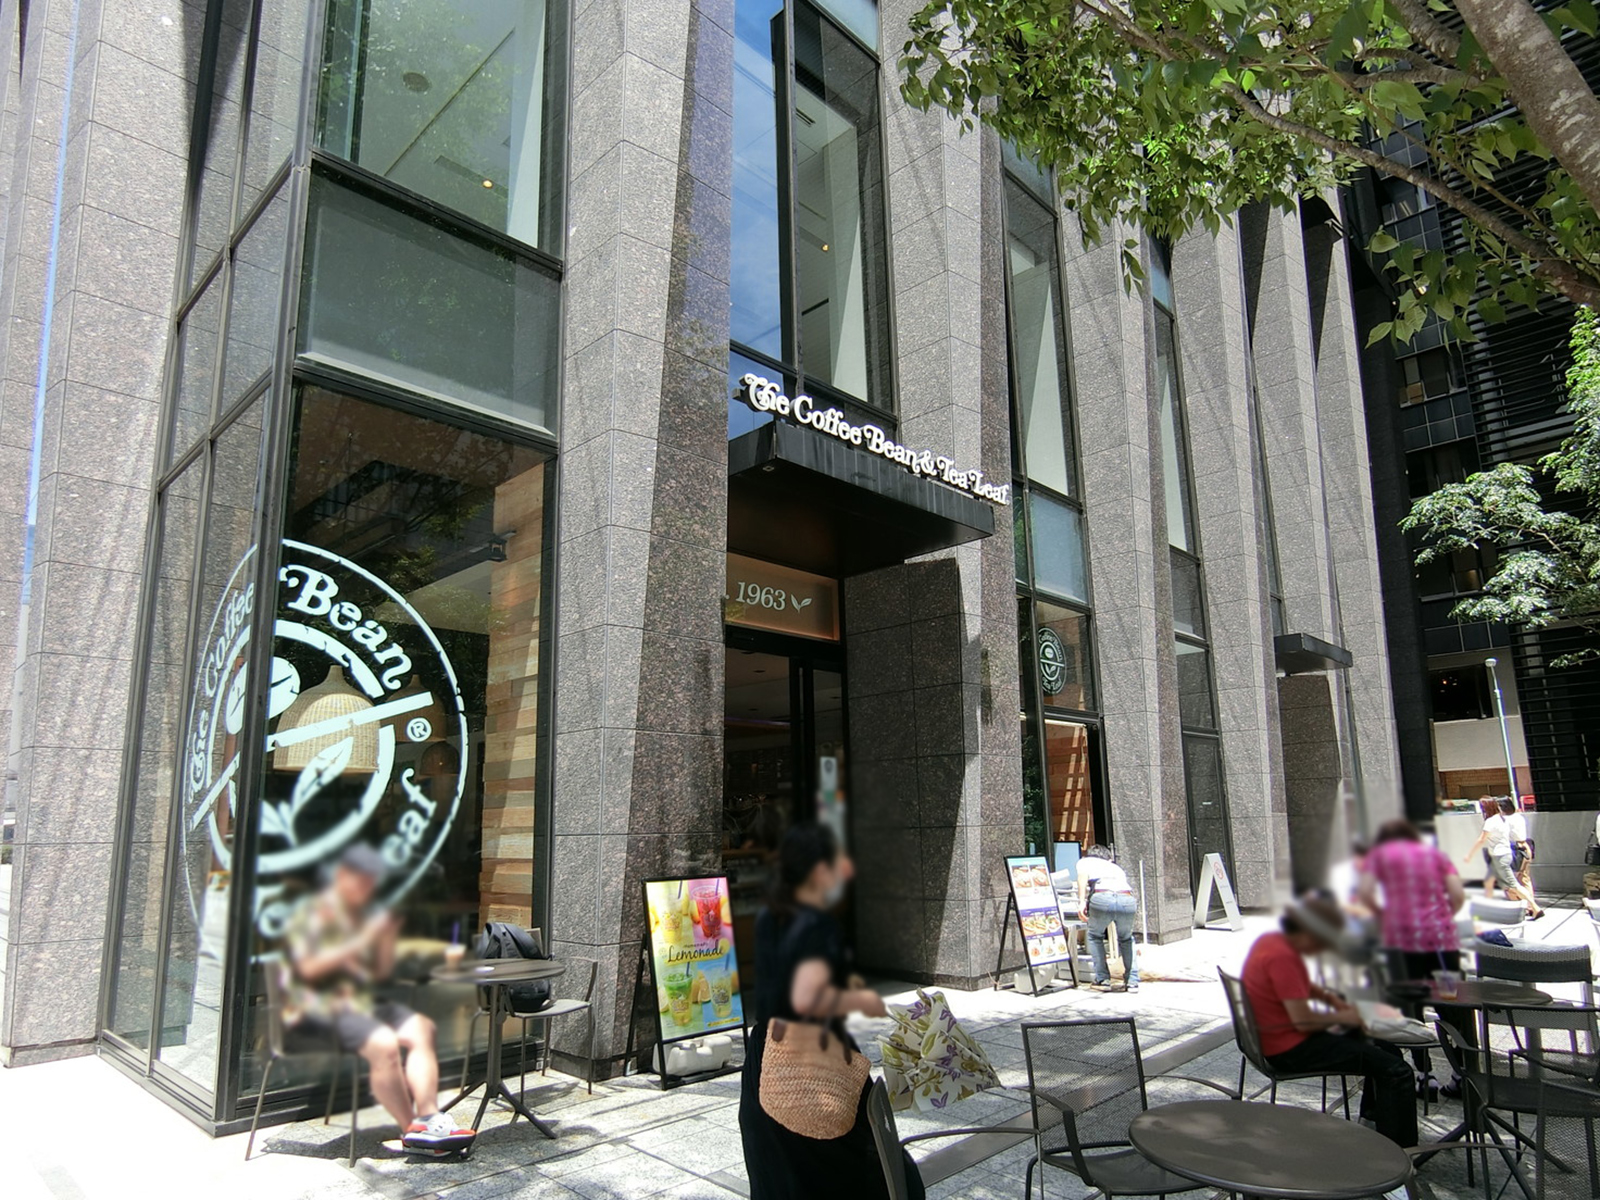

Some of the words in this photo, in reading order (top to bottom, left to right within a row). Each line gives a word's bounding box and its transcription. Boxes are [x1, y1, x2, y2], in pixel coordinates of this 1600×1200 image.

[744, 373, 790, 416] The
[794, 395, 863, 446] Coffee
[864, 424, 922, 474] Bean
[919, 450, 938, 477] &
[936, 456, 969, 489] Tea
[968, 470, 1009, 505] Leaf
[205, 582, 255, 697] Coffee
[278, 564, 412, 690] Bean
[735, 581, 787, 611] 1963
[381, 767, 438, 867] eaf
[668, 939, 724, 963] Lemonade
